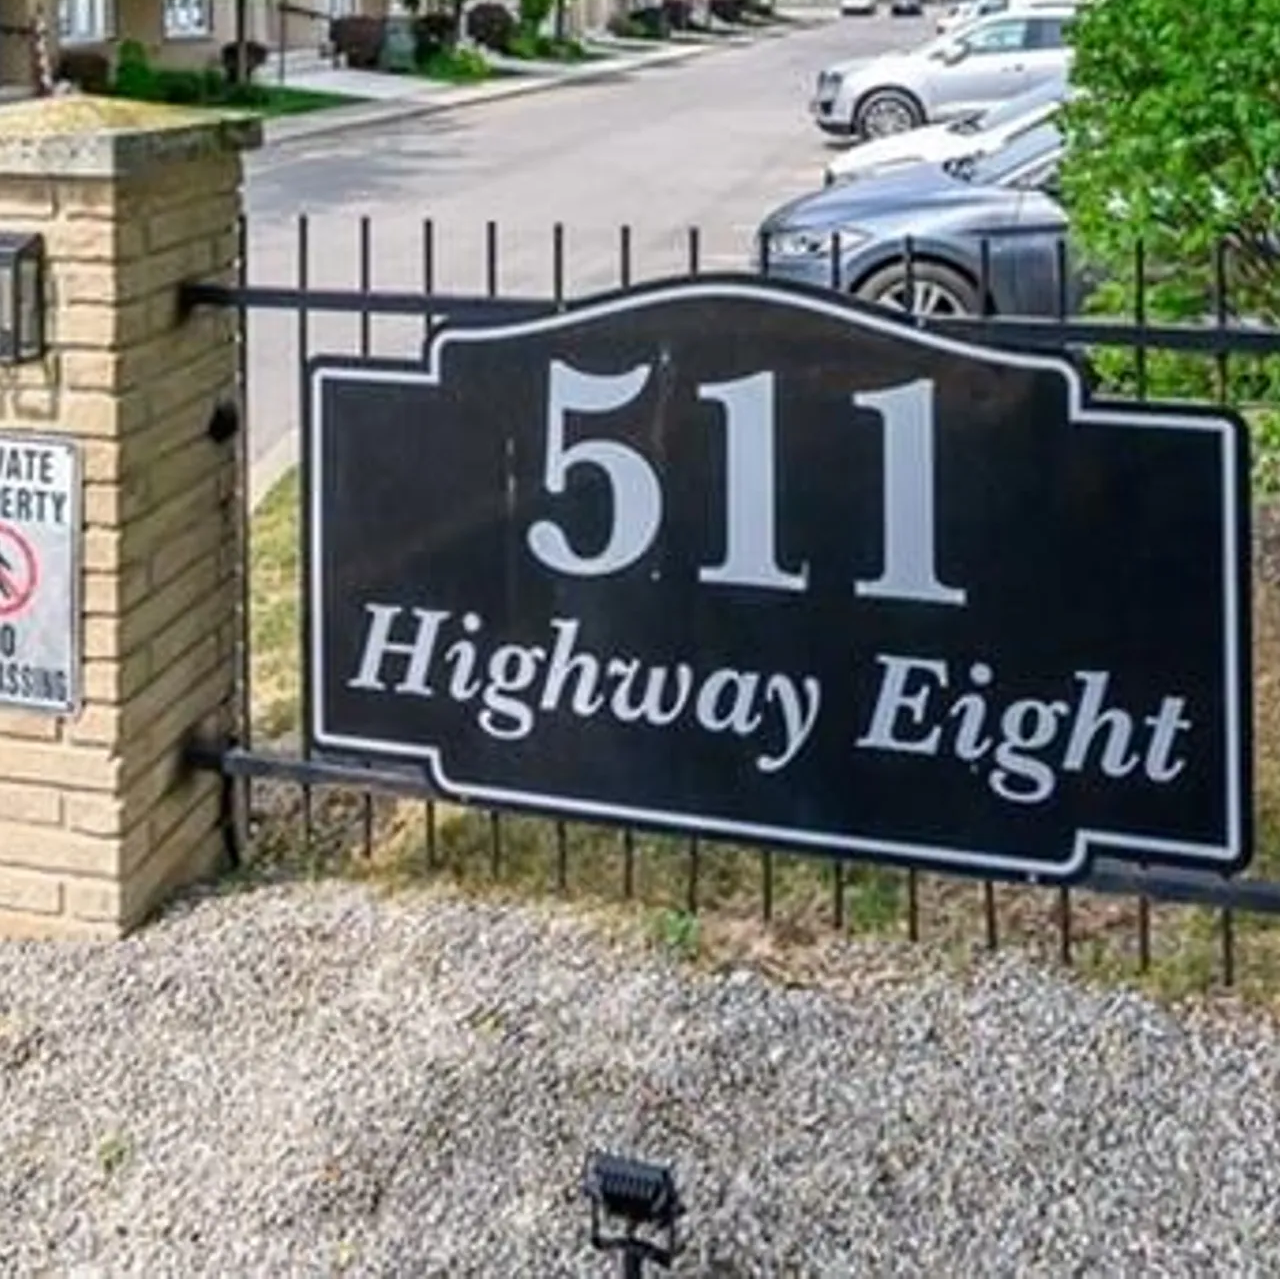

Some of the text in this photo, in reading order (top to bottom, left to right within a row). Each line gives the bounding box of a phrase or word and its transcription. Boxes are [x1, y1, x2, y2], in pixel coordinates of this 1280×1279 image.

[528, 360, 966, 604] 511
[348, 602, 1190, 802] Highway Eight
